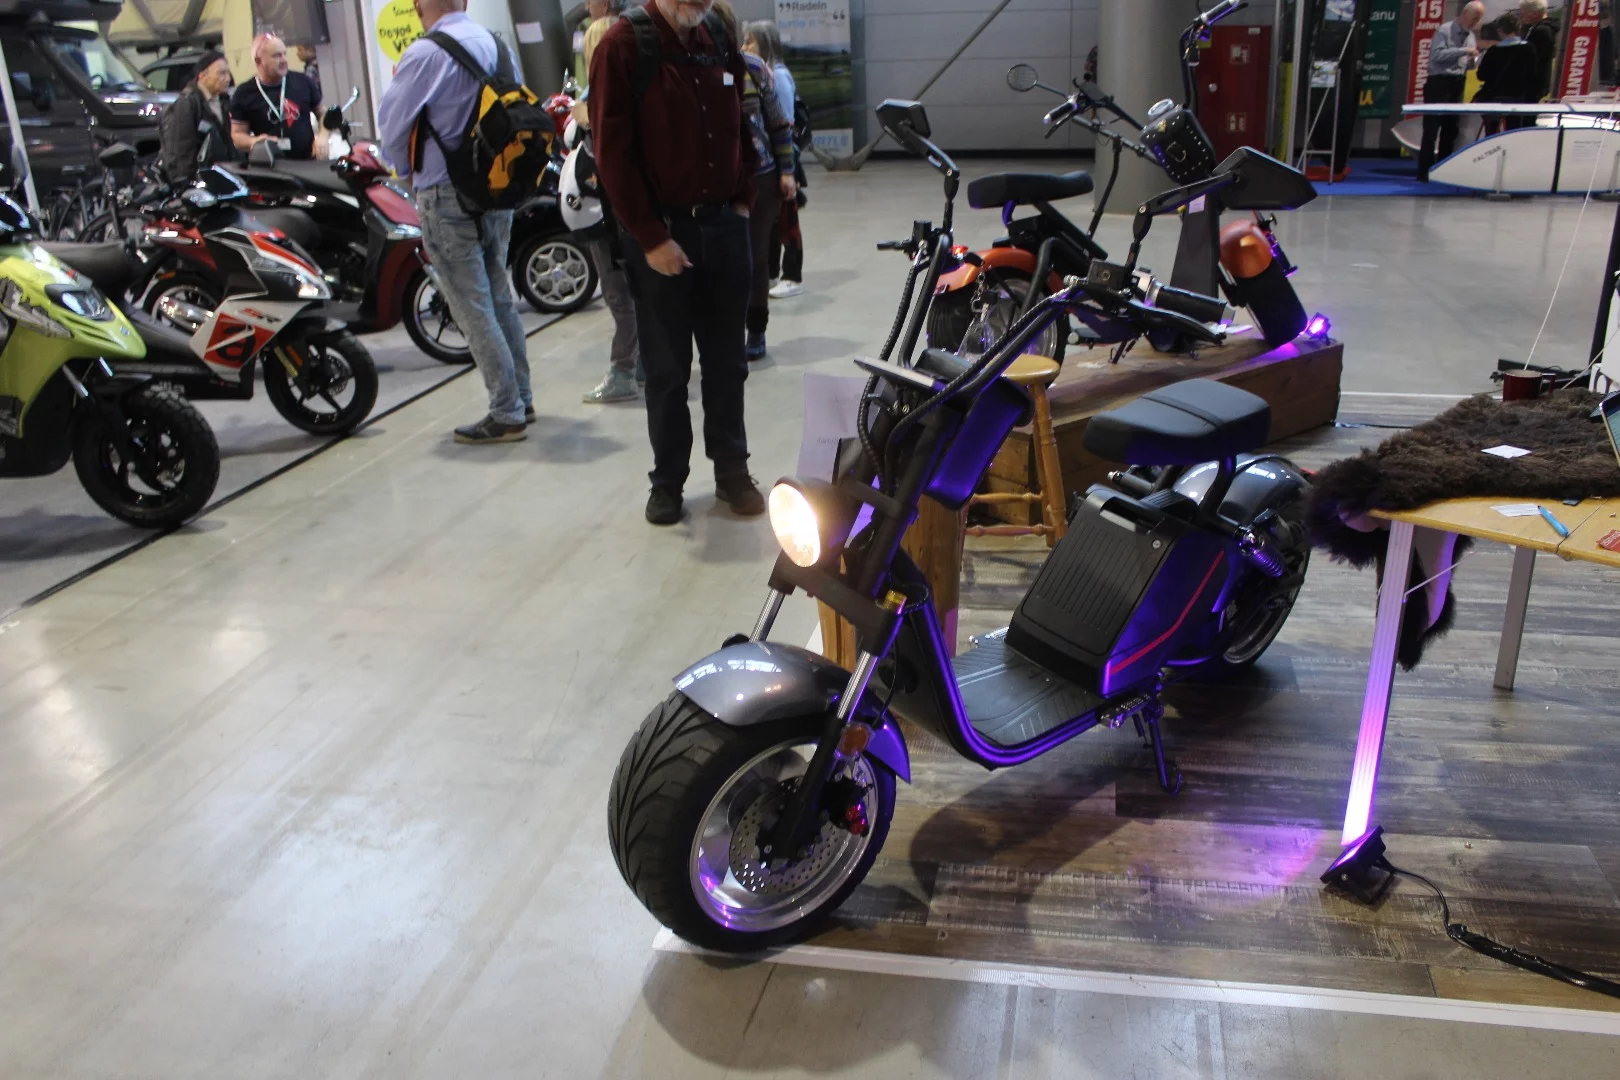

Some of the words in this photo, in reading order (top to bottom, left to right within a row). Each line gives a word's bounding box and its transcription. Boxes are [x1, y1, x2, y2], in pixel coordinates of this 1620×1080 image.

[1417, 0, 1442, 20] 15
[1577, 0, 1600, 17] 15
[1573, 19, 1599, 28] Jahre
